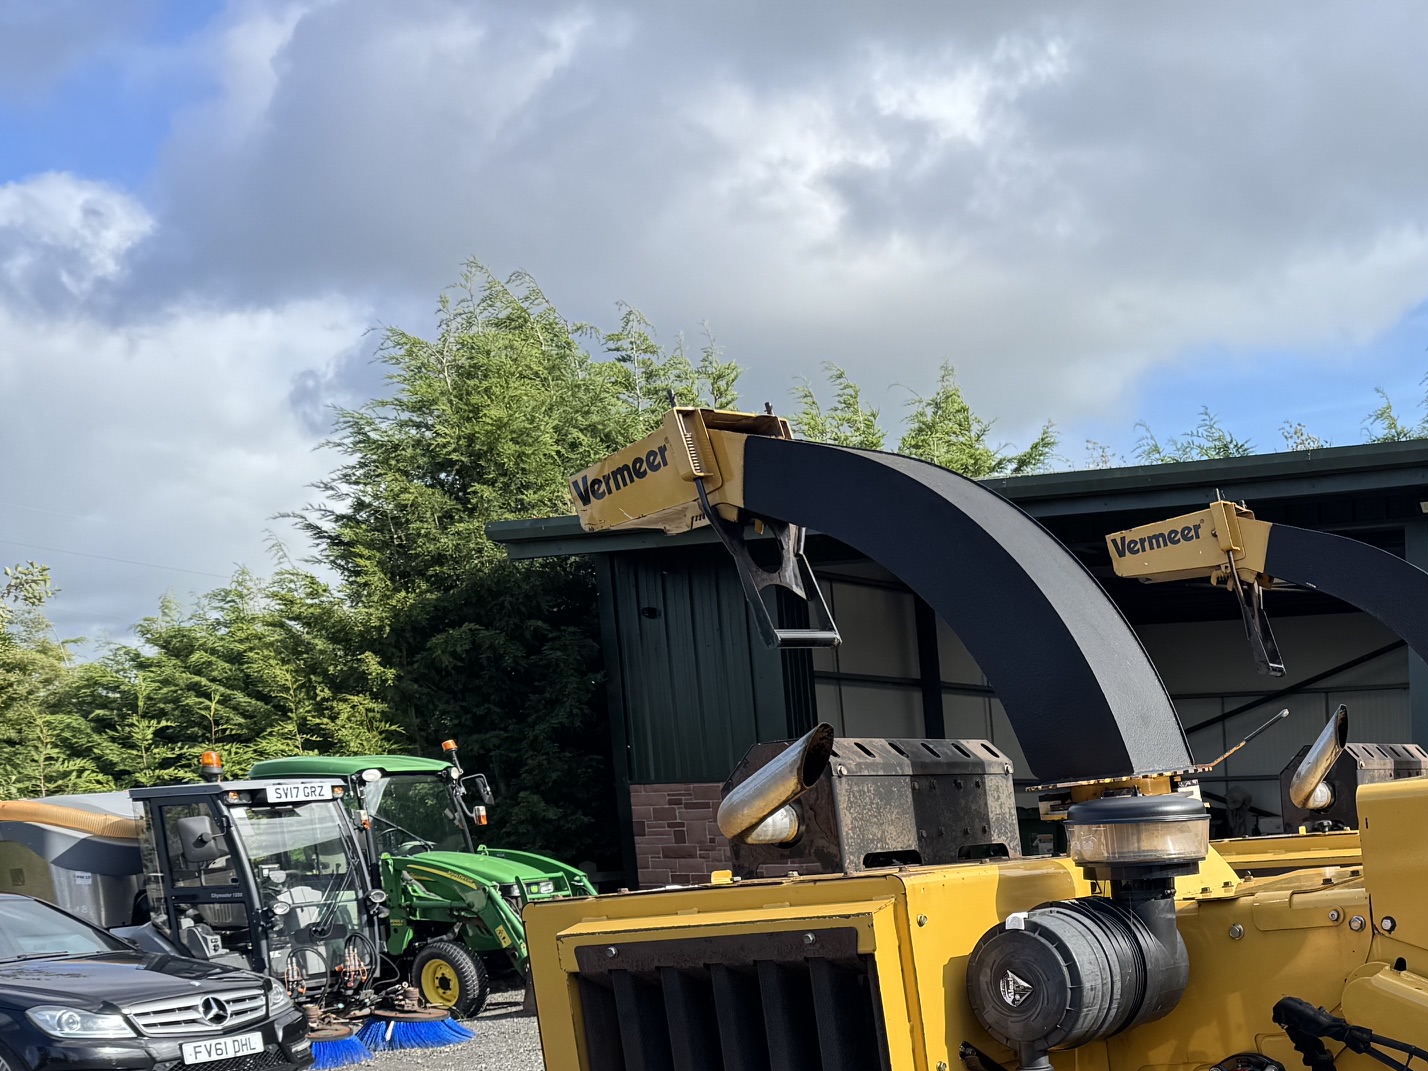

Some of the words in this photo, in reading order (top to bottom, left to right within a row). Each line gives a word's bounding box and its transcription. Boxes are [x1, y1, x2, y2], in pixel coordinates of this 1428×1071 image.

[572, 443, 669, 507] Vermeer
[1111, 523, 1202, 558] Vermeer
[274, 786, 300, 799] SV17
[302, 785, 325, 798] GRZ
[193, 1041, 228, 1060] FV61
[233, 1037, 256, 1055] DHL
